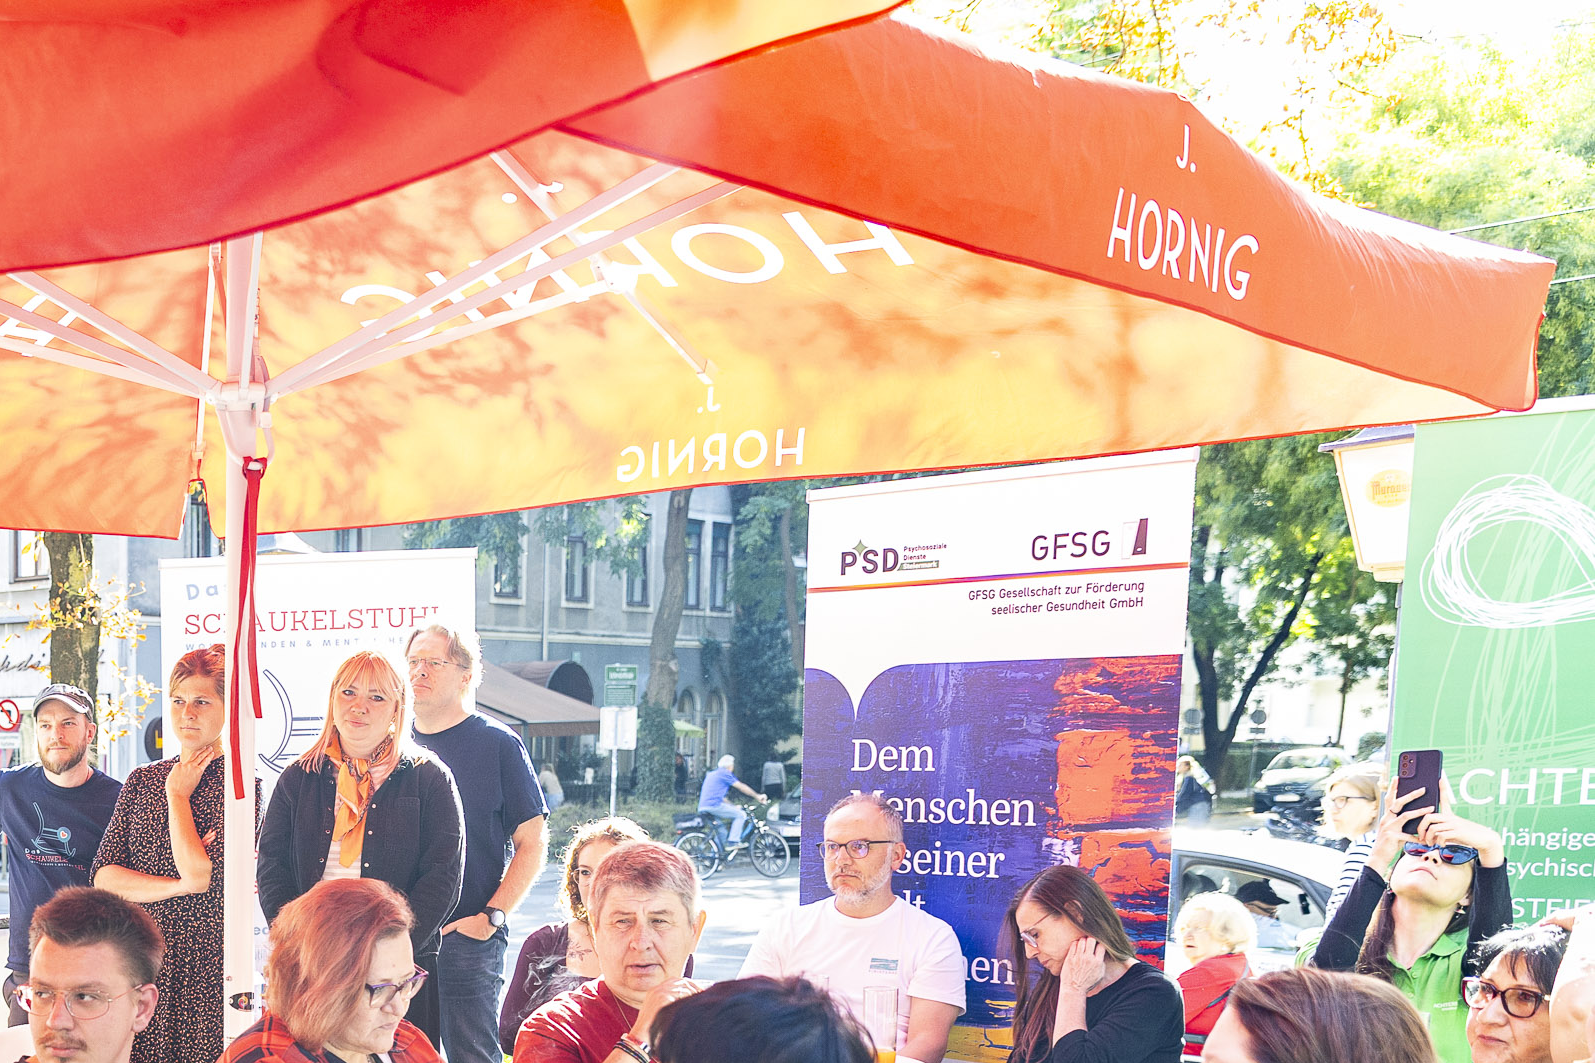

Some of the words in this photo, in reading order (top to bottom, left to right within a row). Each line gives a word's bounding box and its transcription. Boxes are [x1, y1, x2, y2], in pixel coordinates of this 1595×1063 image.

[1176, 124, 1197, 173] J.
[1106, 186, 1260, 301] HORNIG
[1031, 530, 1111, 561] GFSG
[840, 547, 899, 576] PSD
[186, 584, 226, 600] Da
[968, 588, 996, 601] GFSG
[999, 585, 1062, 599] Gesellschaft
[1065, 585, 1083, 594] zur
[1085, 581, 1145, 594] Förderung
[185, 606, 439, 634] SCAUKELSTUH
[991, 602, 1043, 615] seelischer
[1046, 599, 1106, 612] Gesundheit
[1109, 597, 1144, 609] GmbH
[851, 739, 935, 772] Dem
[850, 788, 1037, 827] enschen
[1492, 827, 1595, 851] hängige
[1506, 858, 1595, 880] sychisc
